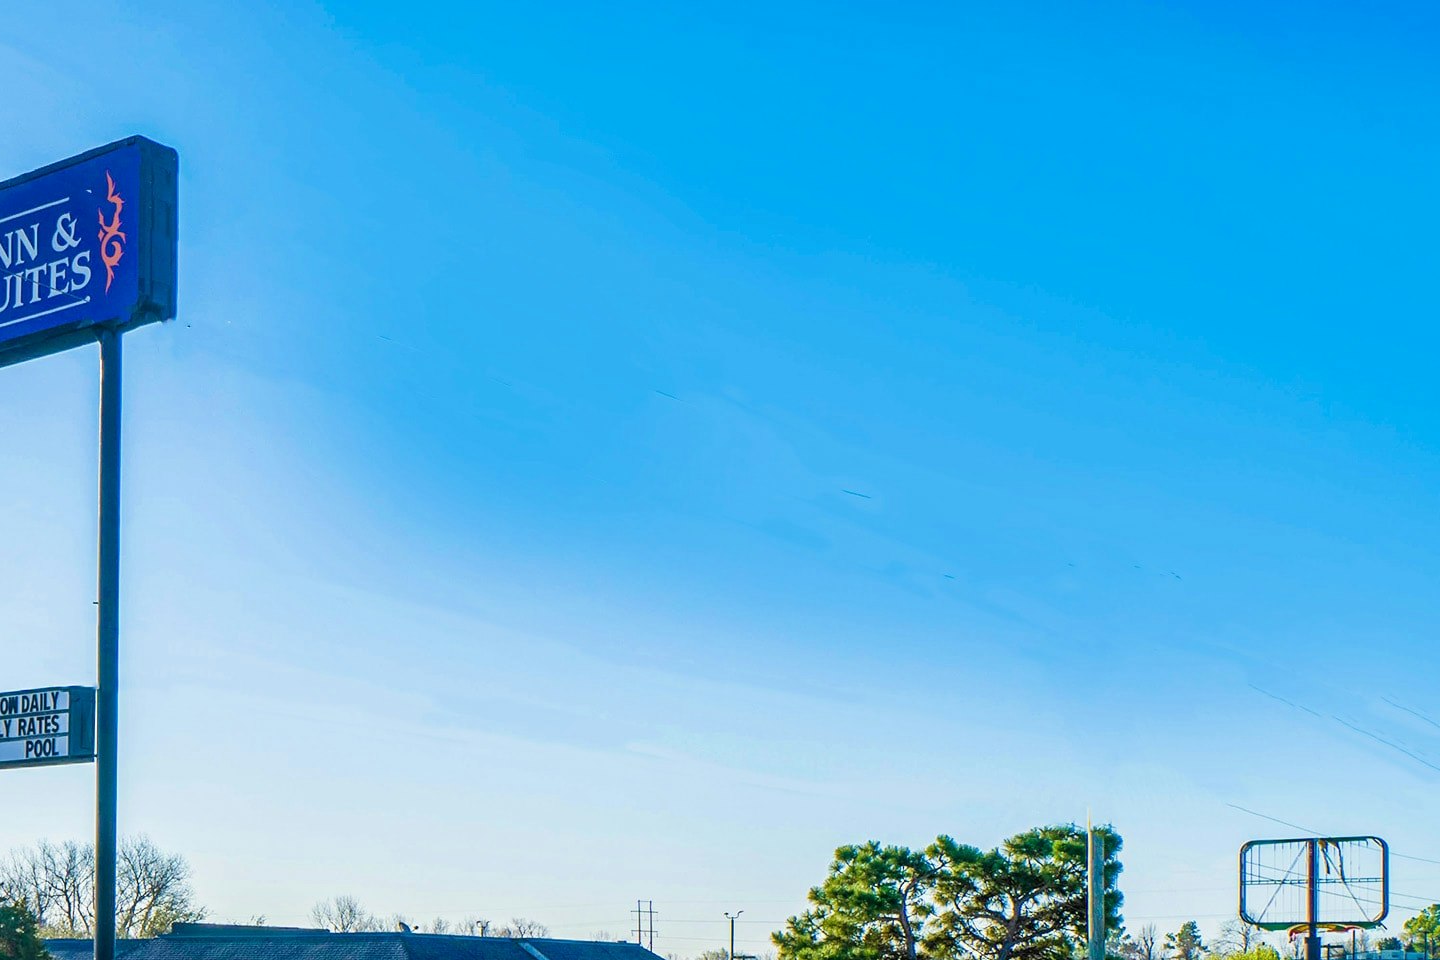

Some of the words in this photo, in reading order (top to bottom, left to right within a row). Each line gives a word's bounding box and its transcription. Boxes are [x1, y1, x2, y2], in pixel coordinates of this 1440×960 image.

[52, 212, 81, 254] &
[21, 691, 59, 714] DAILY
[17, 714, 60, 737] RATES
[25, 738, 60, 759] POOL
